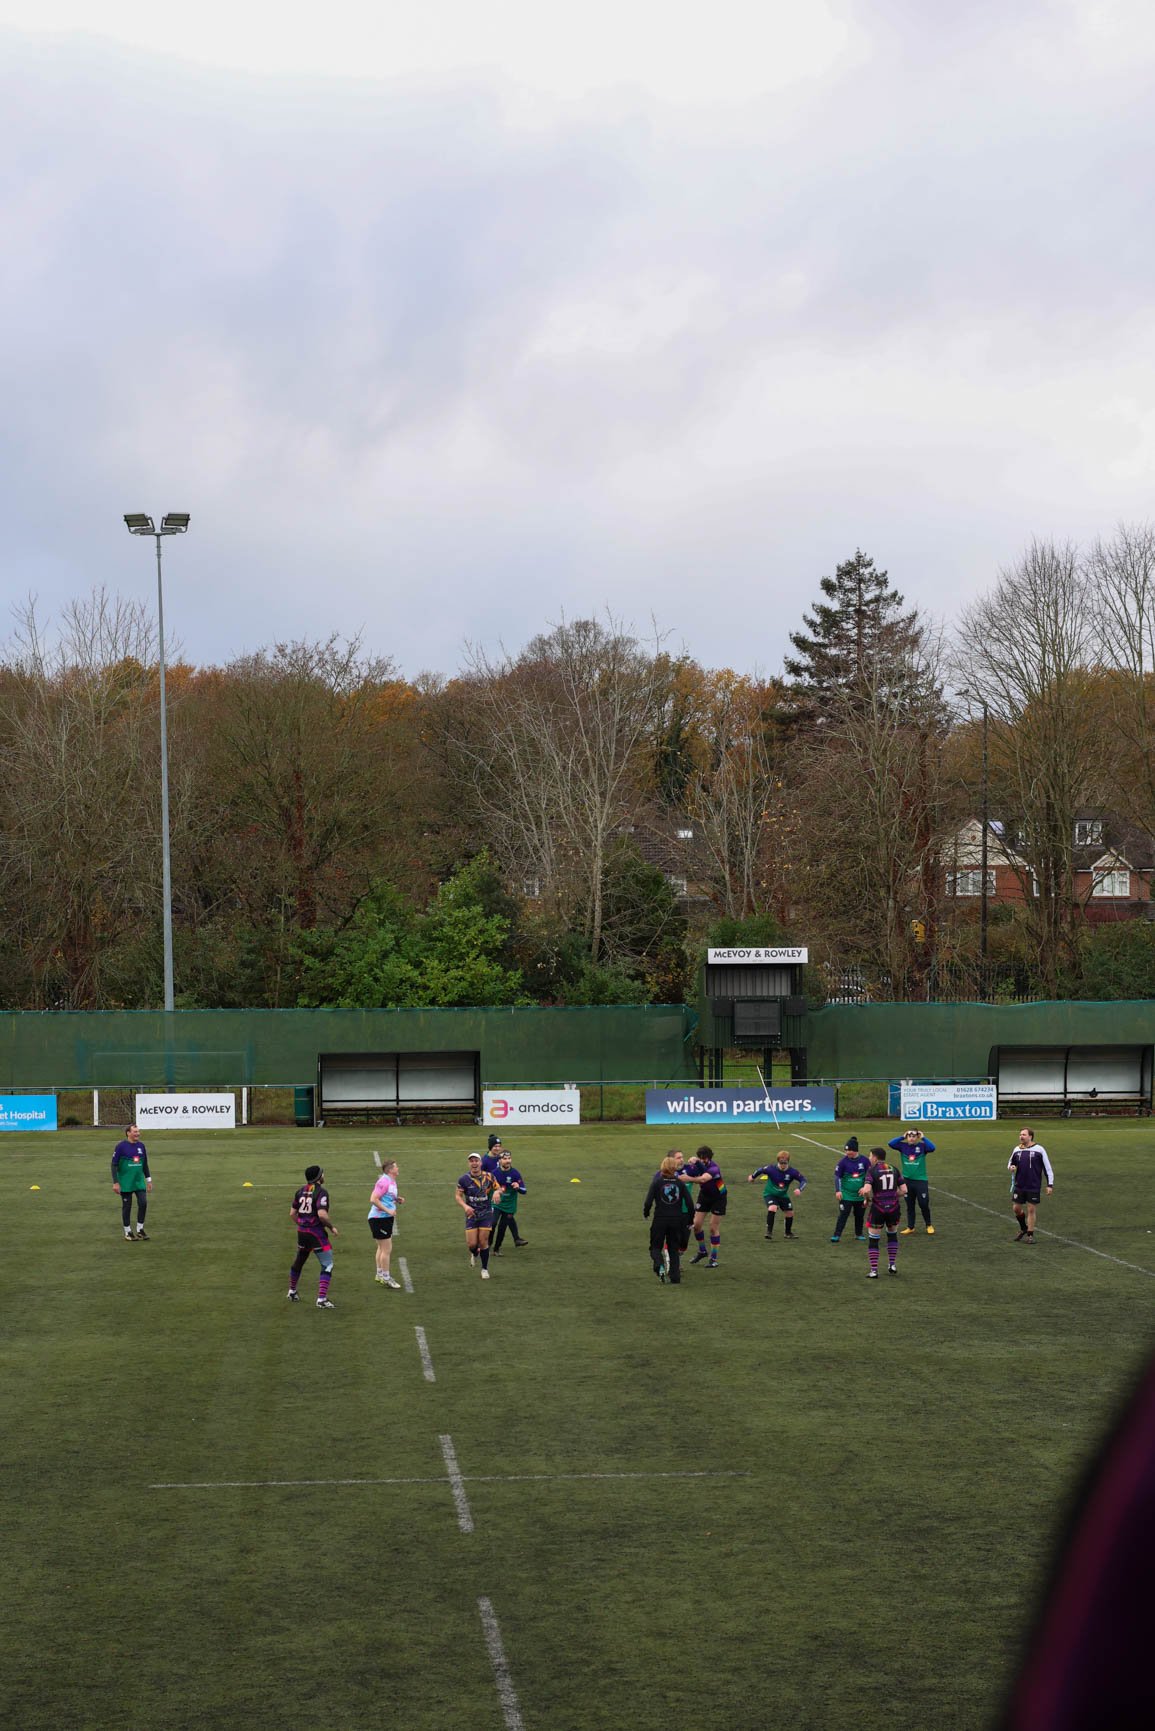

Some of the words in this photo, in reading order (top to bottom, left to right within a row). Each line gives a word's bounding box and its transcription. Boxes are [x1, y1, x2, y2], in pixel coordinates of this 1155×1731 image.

[713, 950, 751, 958] McEVOY
[754, 950, 762, 958] &
[764, 949, 802, 958] ROWLEY
[139, 1105, 179, 1115] McEVOY
[181, 1105, 189, 1114] &
[192, 1105, 231, 1114] ROWLEY
[518, 1101, 574, 1113] amdocs
[666, 1096, 727, 1113] wilson
[926, 1103, 991, 1117] Braxton
[9, 1110, 46, 1120] Hospital
[879, 1173, 895, 1191] 17
[299, 1196, 312, 1213] 23
